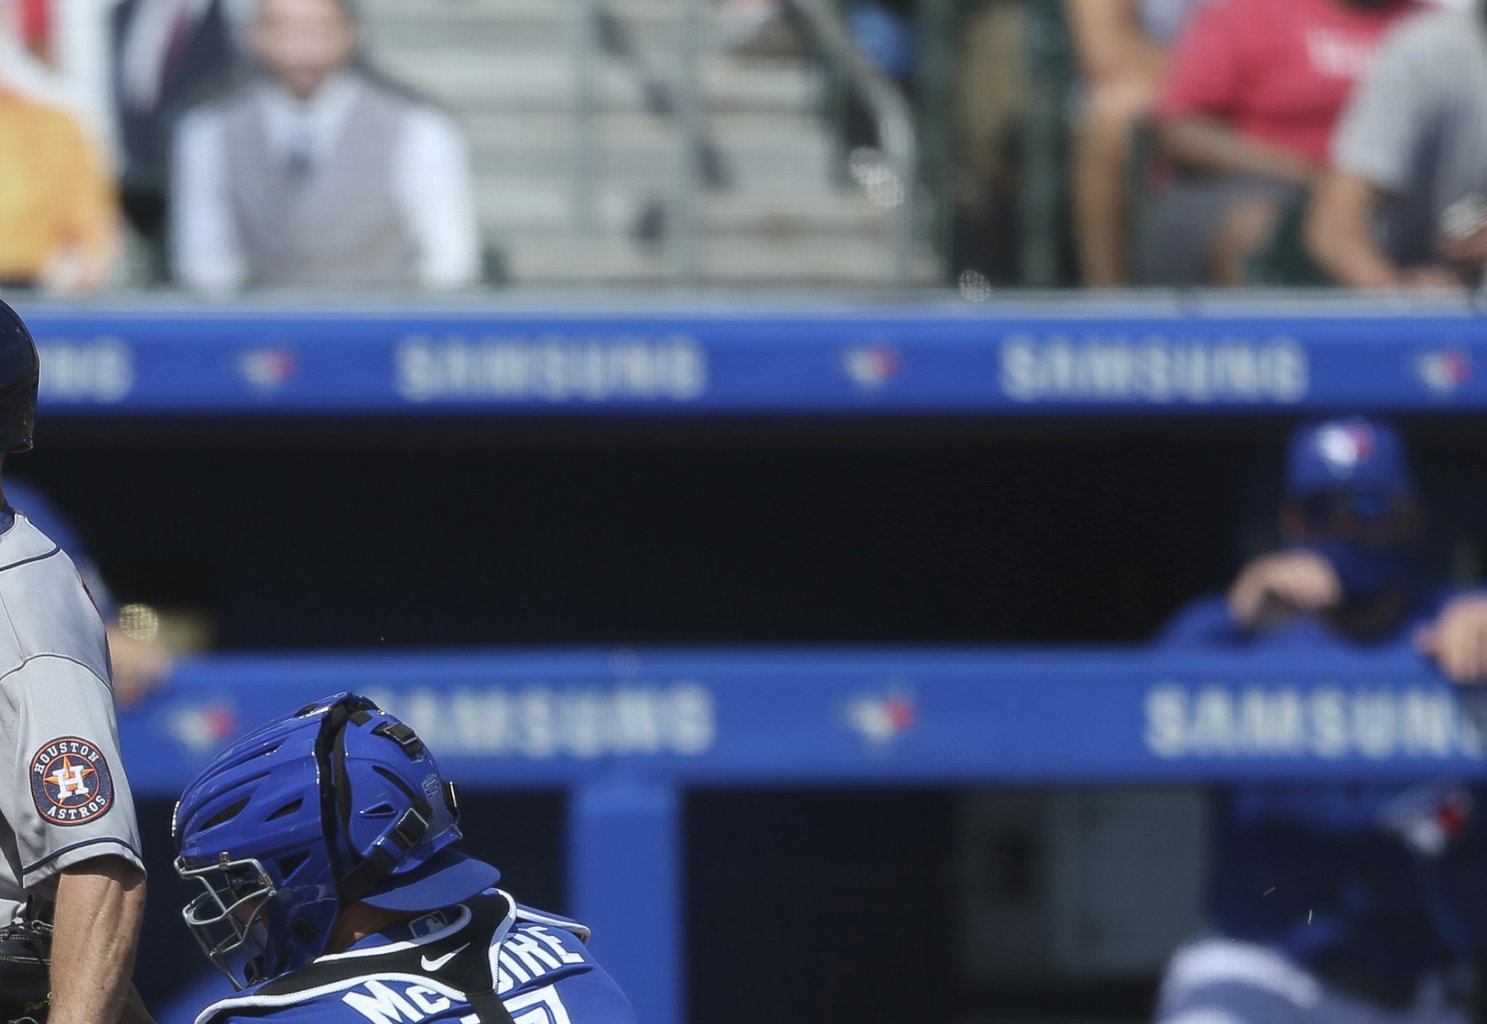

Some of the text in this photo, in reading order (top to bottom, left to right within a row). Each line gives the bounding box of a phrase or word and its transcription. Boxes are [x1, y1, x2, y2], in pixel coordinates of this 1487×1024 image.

[394, 337, 708, 402] SAMSUNG
[999, 336, 1310, 402] SAMSUNG
[1142, 680, 1485, 760] SAMSUN
[34, 742, 99, 775] HOUSTON
[47, 795, 106, 820] ASTROS
